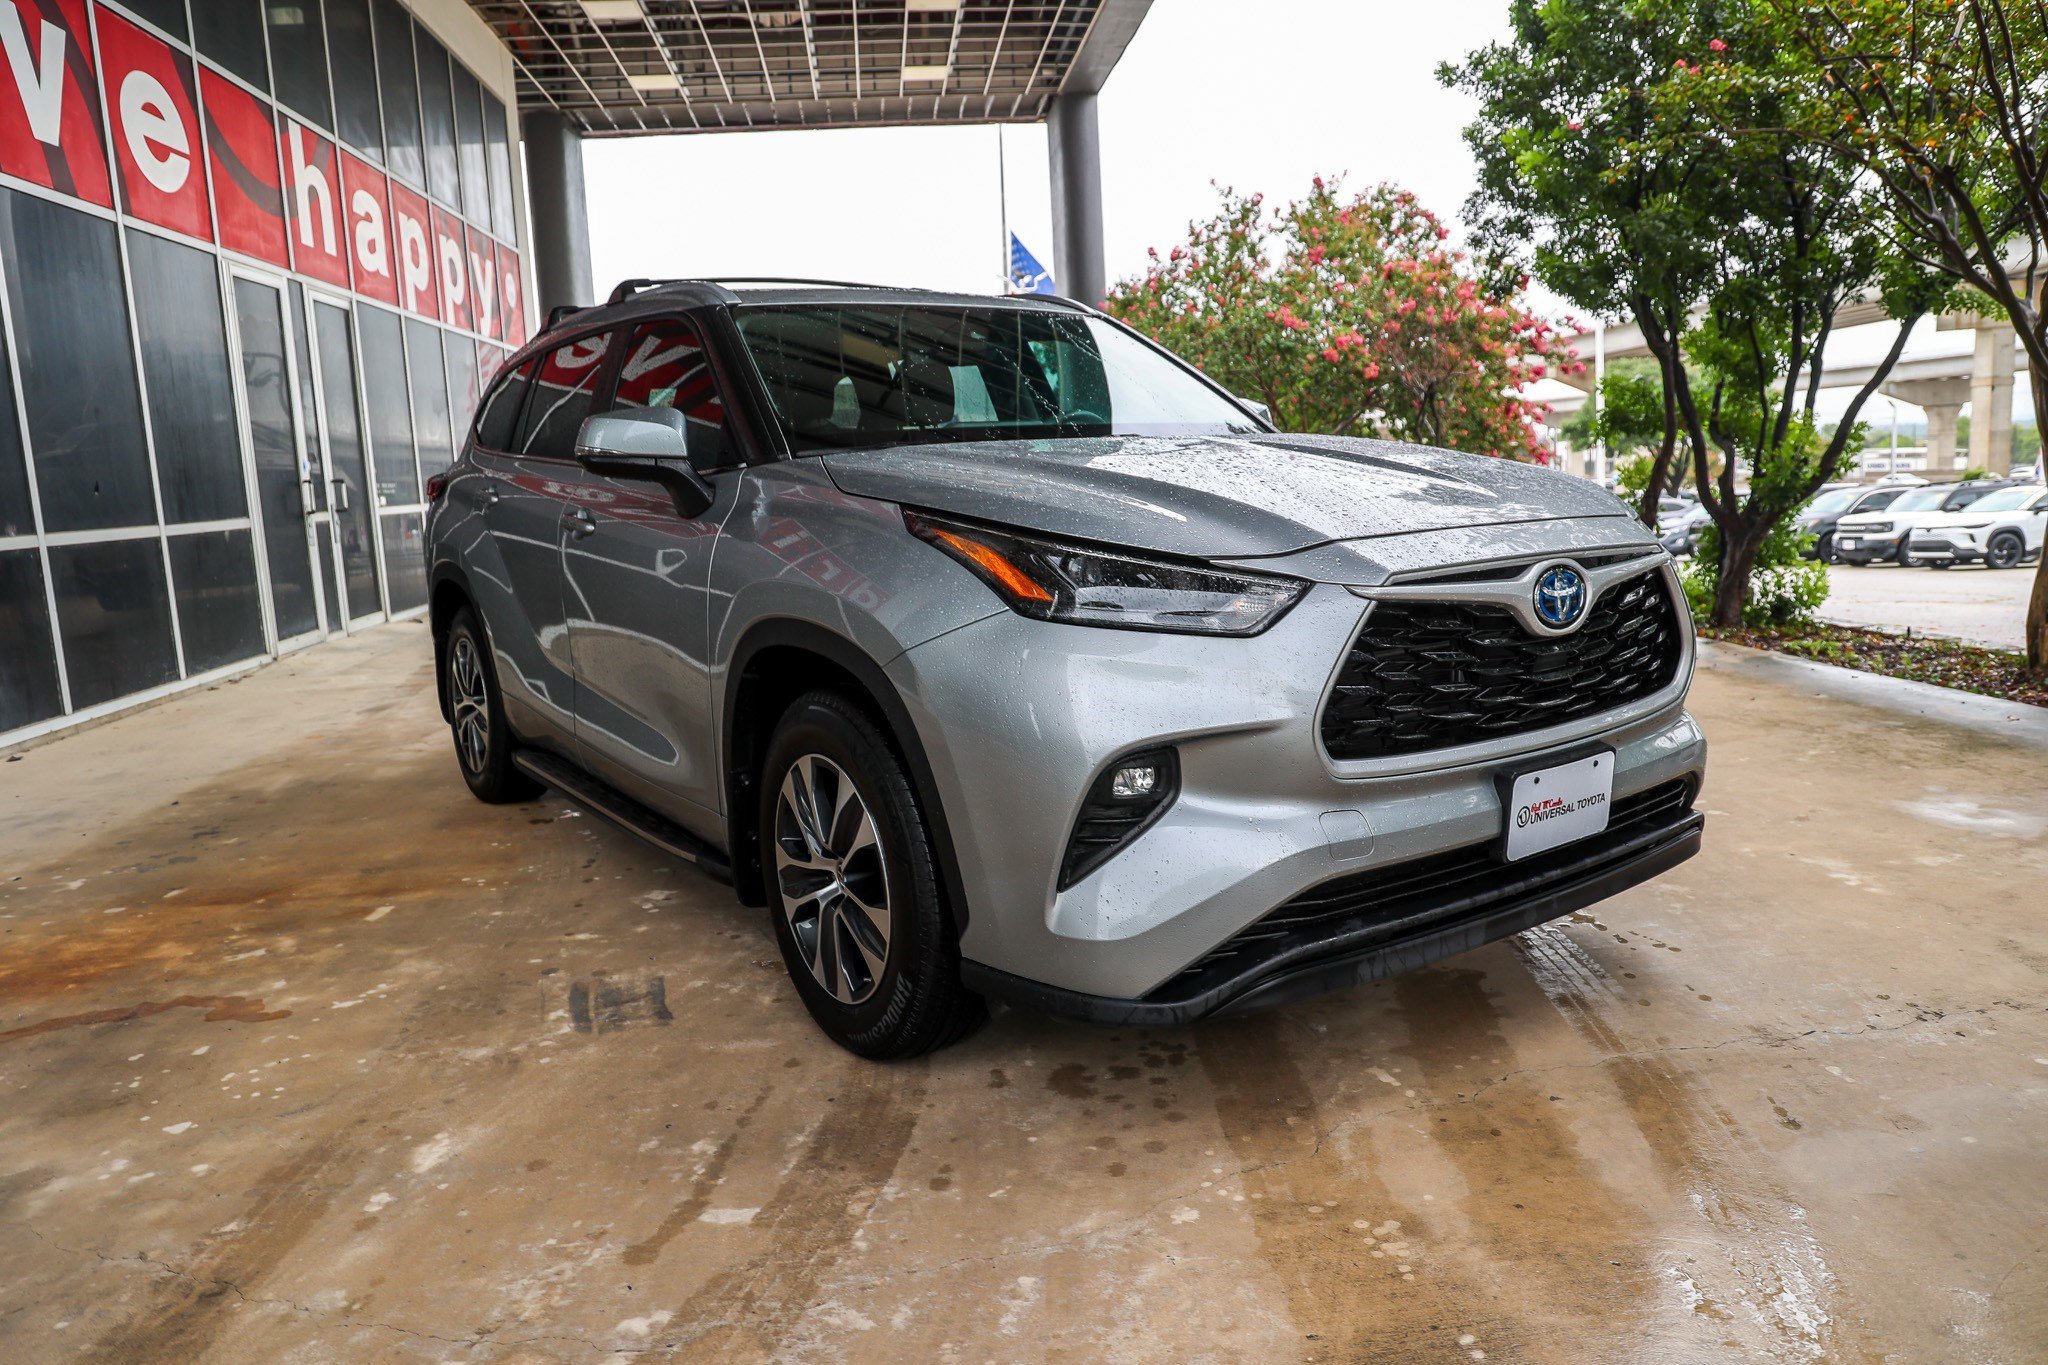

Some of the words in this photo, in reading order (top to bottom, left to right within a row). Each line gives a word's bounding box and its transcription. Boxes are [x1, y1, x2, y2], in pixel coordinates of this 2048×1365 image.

[0, 0, 191, 194] ve
[1530, 803, 1575, 824] UNIVERSAL
[1577, 792, 1605, 809] TOYOTA
